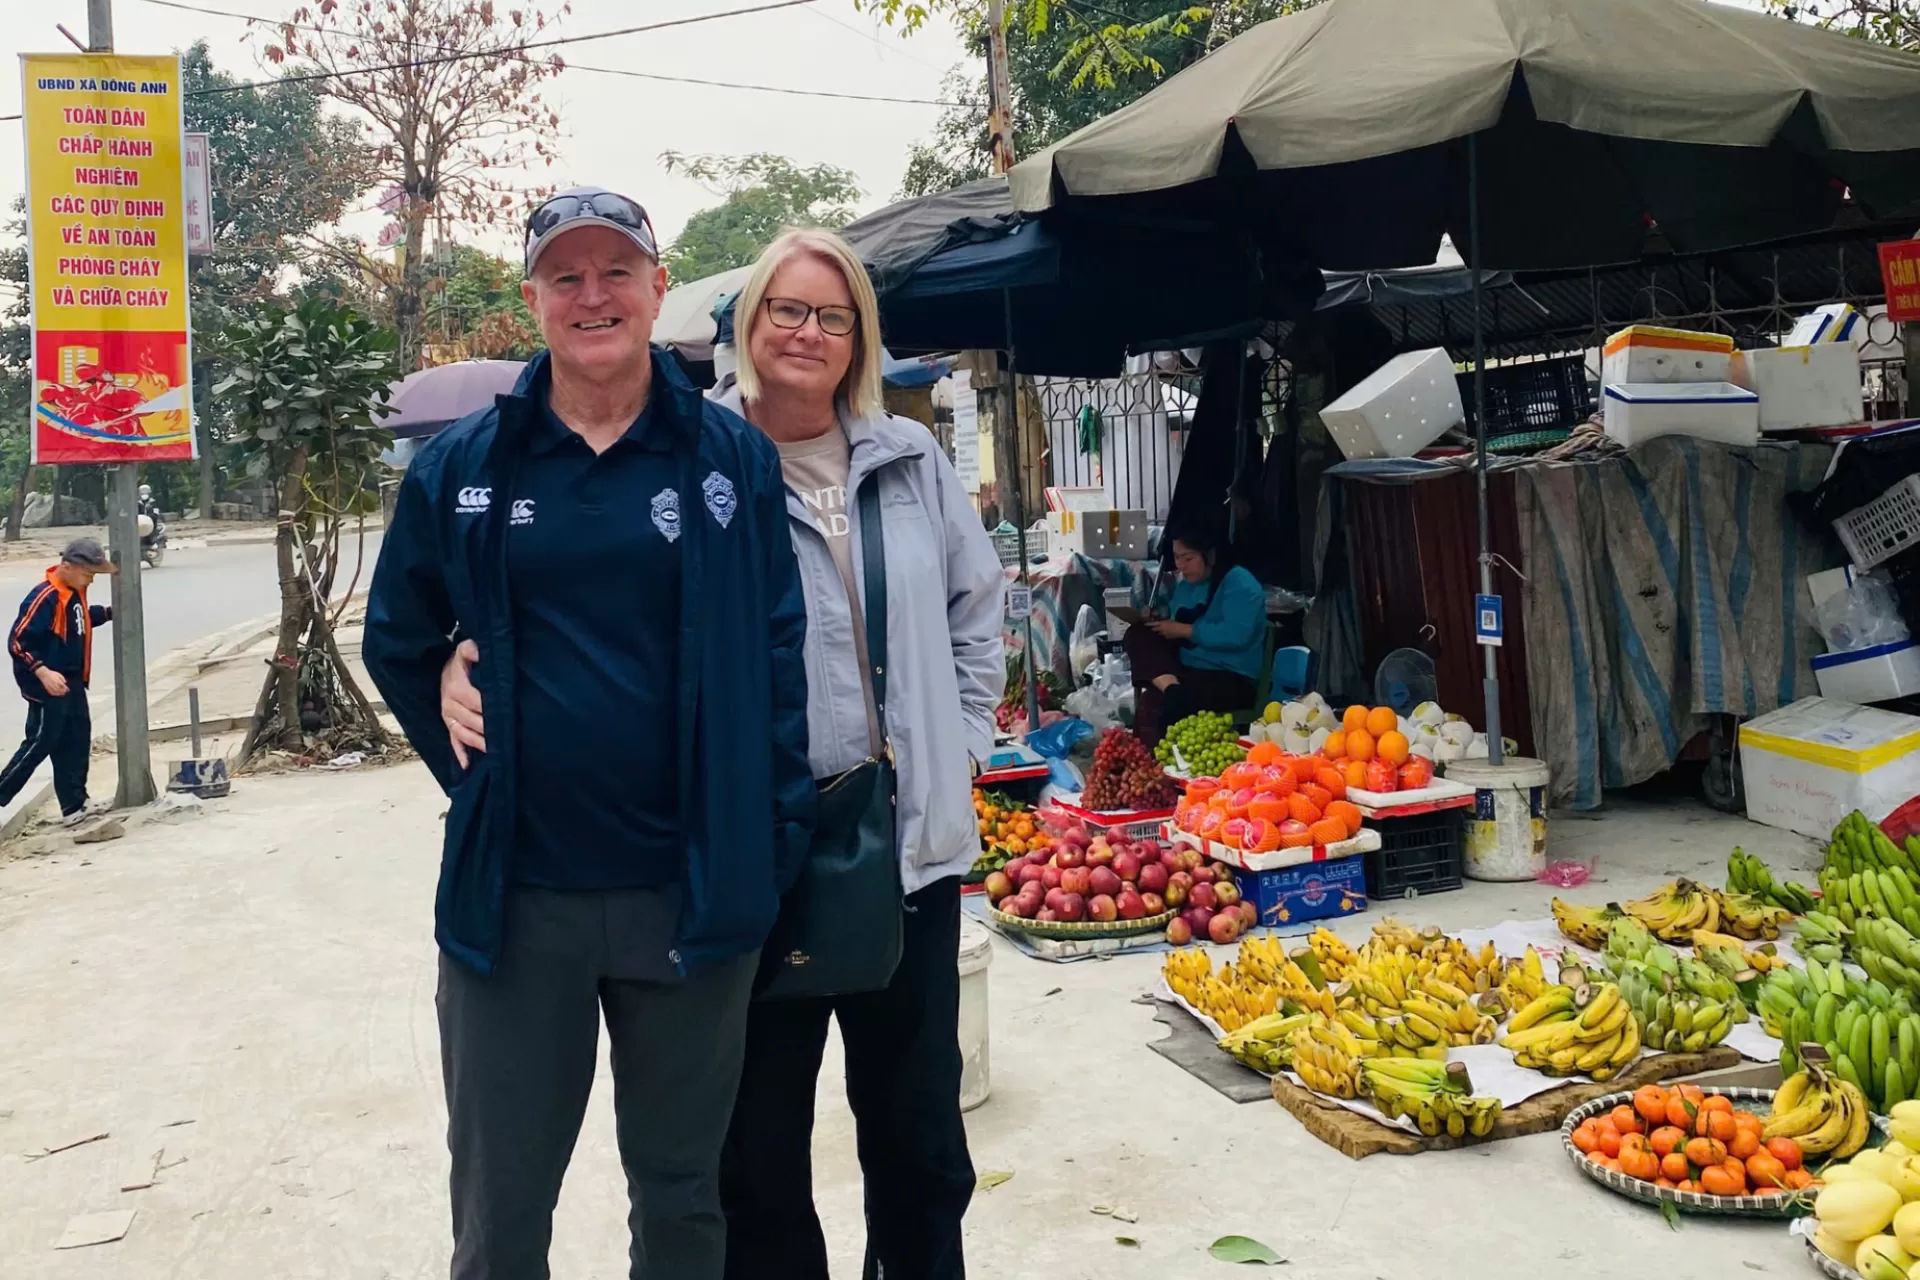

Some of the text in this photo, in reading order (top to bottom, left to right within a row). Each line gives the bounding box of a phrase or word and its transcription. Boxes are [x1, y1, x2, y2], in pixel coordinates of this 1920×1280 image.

[37, 78, 75, 90] UBND
[80, 78, 97, 91] XÃ
[140, 82, 167, 94] ANH
[63, 105, 146, 127] TOÀN DÂN
[58, 133, 153, 157] CHẤP HÀNH
[75, 166, 139, 186] NGHIÊM
[51, 195, 164, 220] CÁC QUY ĐỊNH
[88, 229, 110, 245] AN
[114, 227, 156, 247] TOÀN
[59, 255, 160, 277] PHÒNG CHÁY
[53, 285, 168, 307] VÀ CHỮA CHÁY
